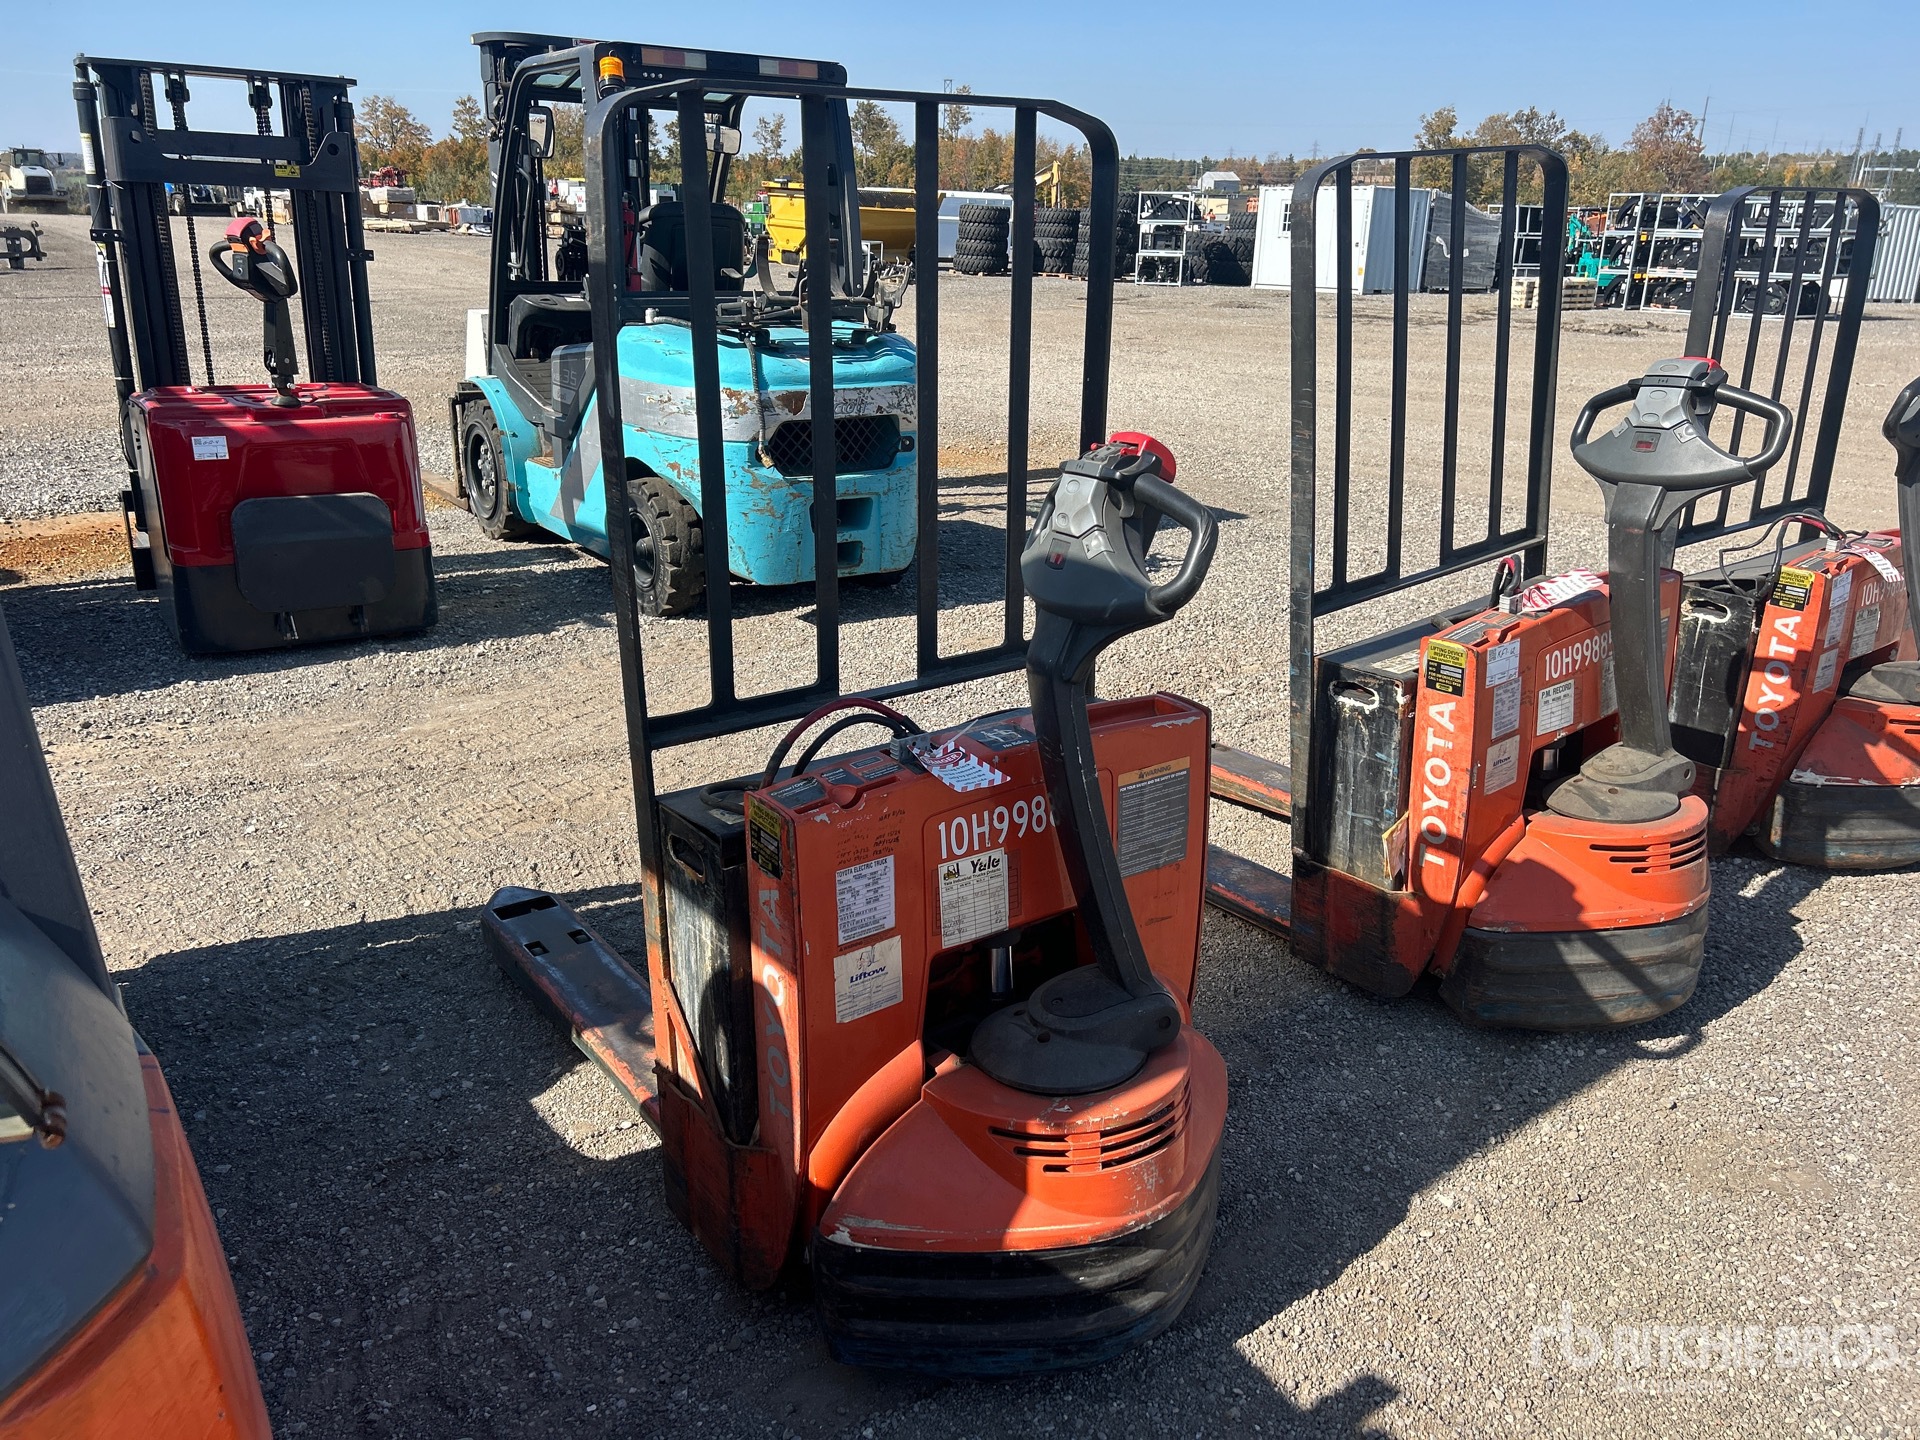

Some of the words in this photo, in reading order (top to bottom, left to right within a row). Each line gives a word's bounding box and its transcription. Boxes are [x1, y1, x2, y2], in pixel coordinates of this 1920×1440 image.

[1430, 646, 1448, 654] LIFTING
[1434, 652, 1460, 662] INSPECTION
[1552, 682, 1572, 696] RECORD
[1748, 615, 1802, 750] TOYOTA
[1145, 764, 1172, 778] WARNING
[1418, 701, 1456, 868] TOYOTA
[938, 795, 1056, 860] 10H998
[837, 870, 853, 878] TOYOTA
[854, 862, 874, 872] ELECTRIC
[874, 858, 888, 866] TRUCK
[970, 856, 1001, 874] Yale
[953, 875, 972, 885] Industrial
[850, 966, 886, 983] Liftow
[758, 888, 790, 1118] TOYOTA
